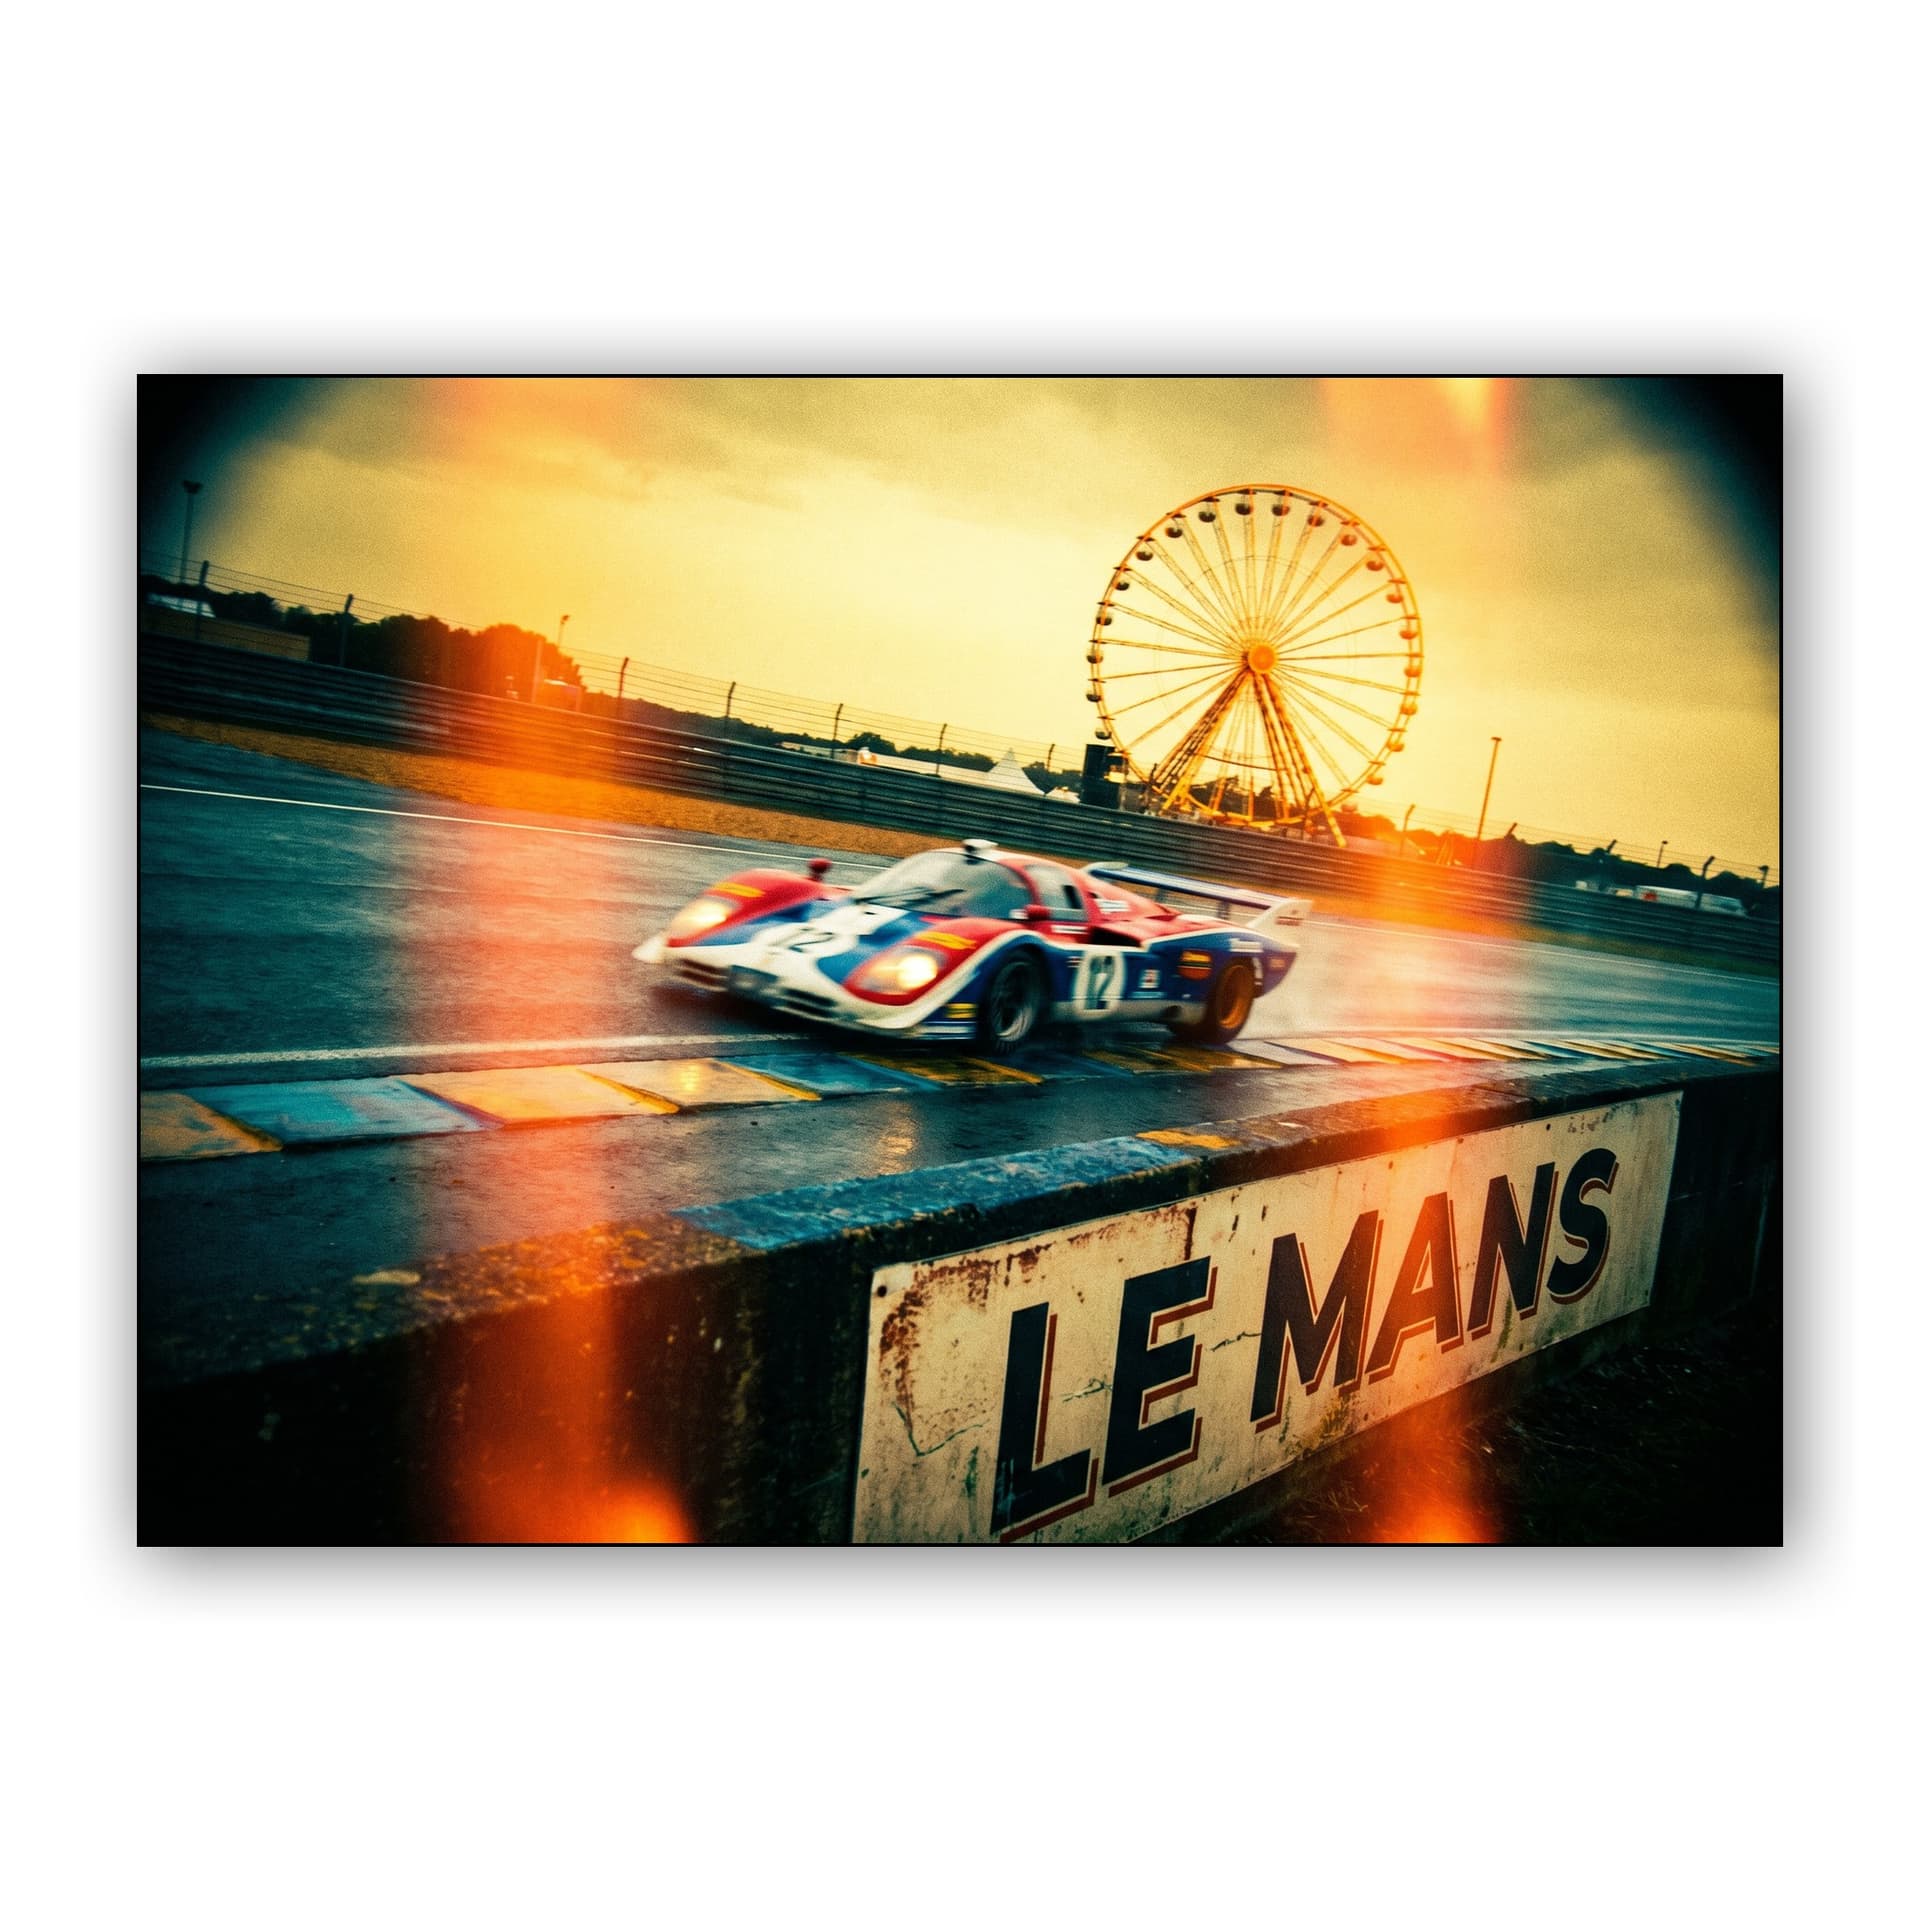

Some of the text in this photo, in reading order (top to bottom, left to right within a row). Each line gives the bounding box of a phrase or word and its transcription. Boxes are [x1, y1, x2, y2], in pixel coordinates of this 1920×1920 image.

[1084, 955, 1115, 1010] 12
[990, 1147, 1619, 1543] LE MANS
